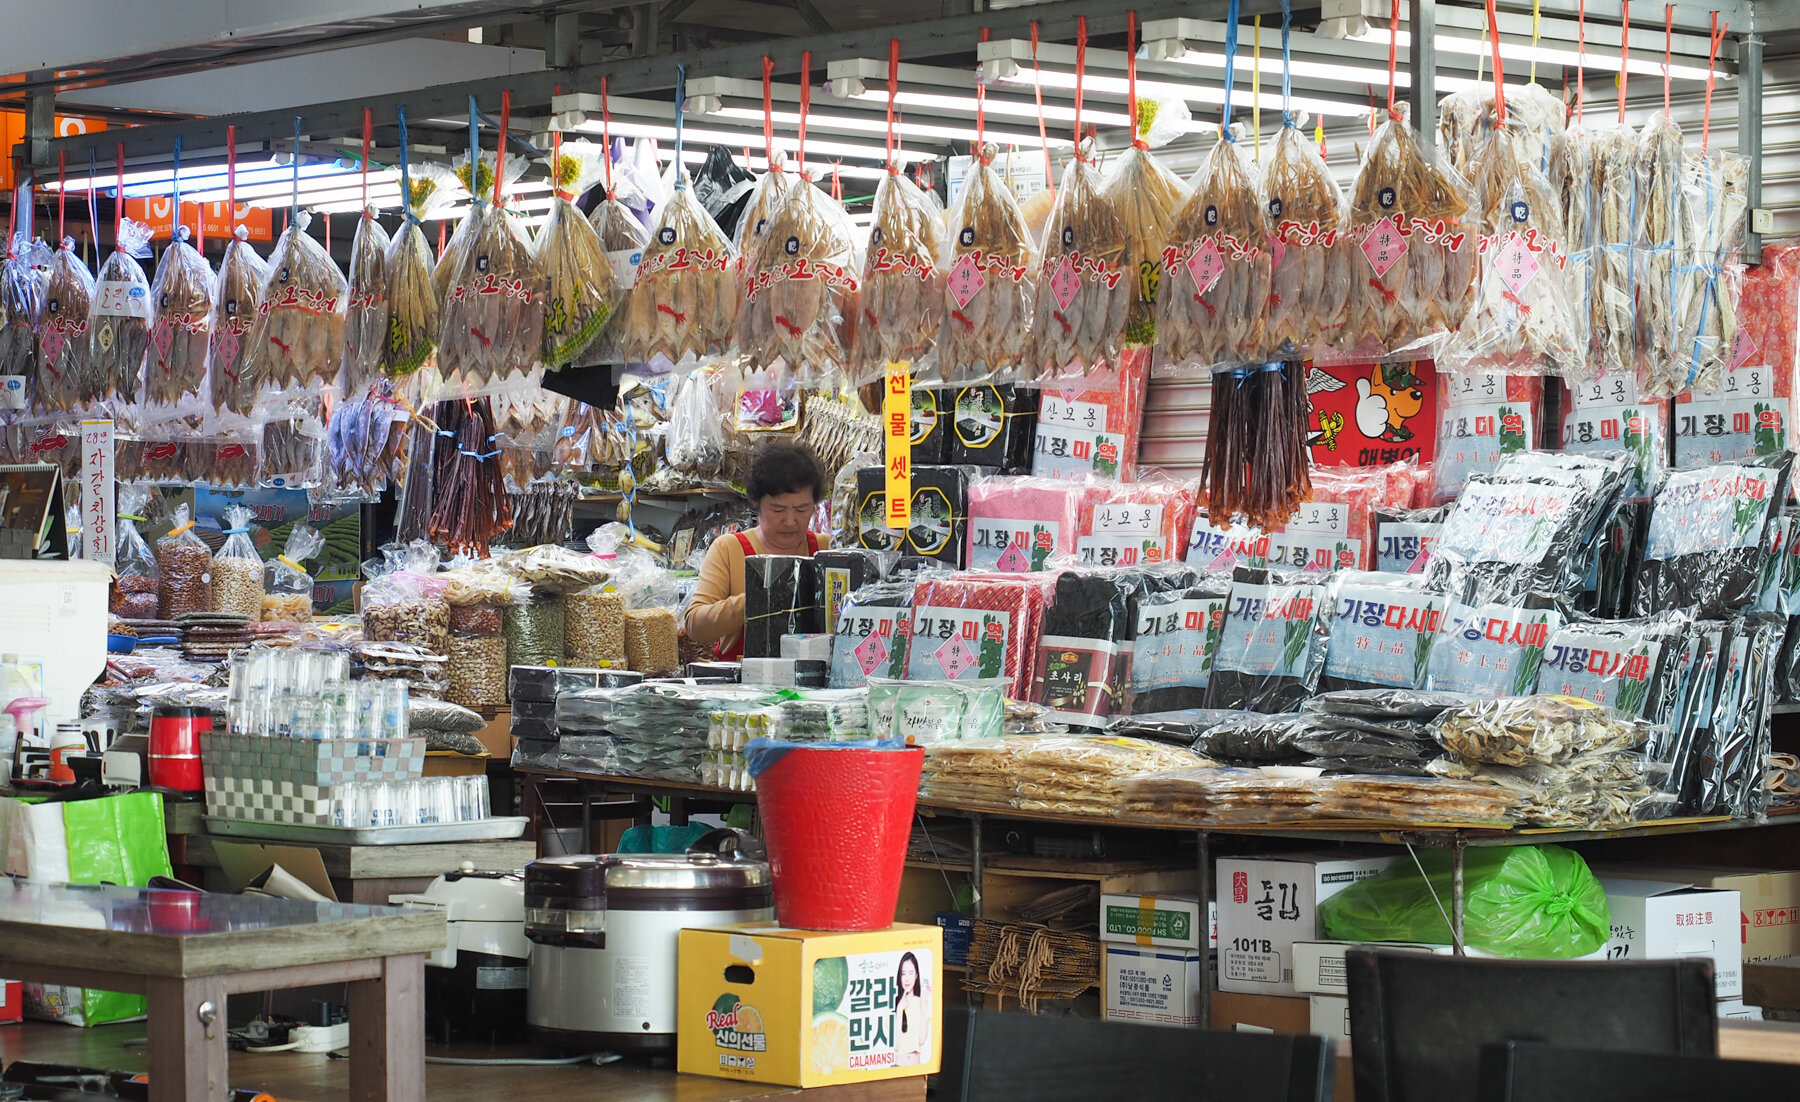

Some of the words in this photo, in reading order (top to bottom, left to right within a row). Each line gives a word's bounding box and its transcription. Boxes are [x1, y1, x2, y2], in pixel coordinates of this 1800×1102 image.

[669, 248, 729, 272] 오징어
[873, 248, 935, 282] 오징어
[972, 250, 1027, 282] 오징어
[479, 274, 532, 304] 오징어
[788, 258, 858, 292] 오징어
[280, 286, 337, 311] 오징어
[1046, 403, 1098, 427] 산모용
[1680, 409, 1782, 438] 기장미역
[889, 374, 908, 519] 선물셋트
[1036, 433, 1118, 464] 기장미역
[88, 447, 110, 554] 자갈치상회
[1099, 508, 1152, 529] 산모용
[977, 527, 1053, 553] 기장미역
[918, 617, 1003, 644] 기장미역
[1048, 670, 1083, 685] 초사리
[1548, 643, 1650, 683] 기장다시마
[1254, 880, 1300, 922] 돌김
[1675, 911, 1713, 927] 取扱注意
[849, 976, 899, 1013] 깔라
[706, 1002, 741, 1030] Real
[715, 1029, 766, 1051] 신의선물
[849, 1015, 896, 1053] 만시
[849, 1052, 895, 1069] CALAMANSI
